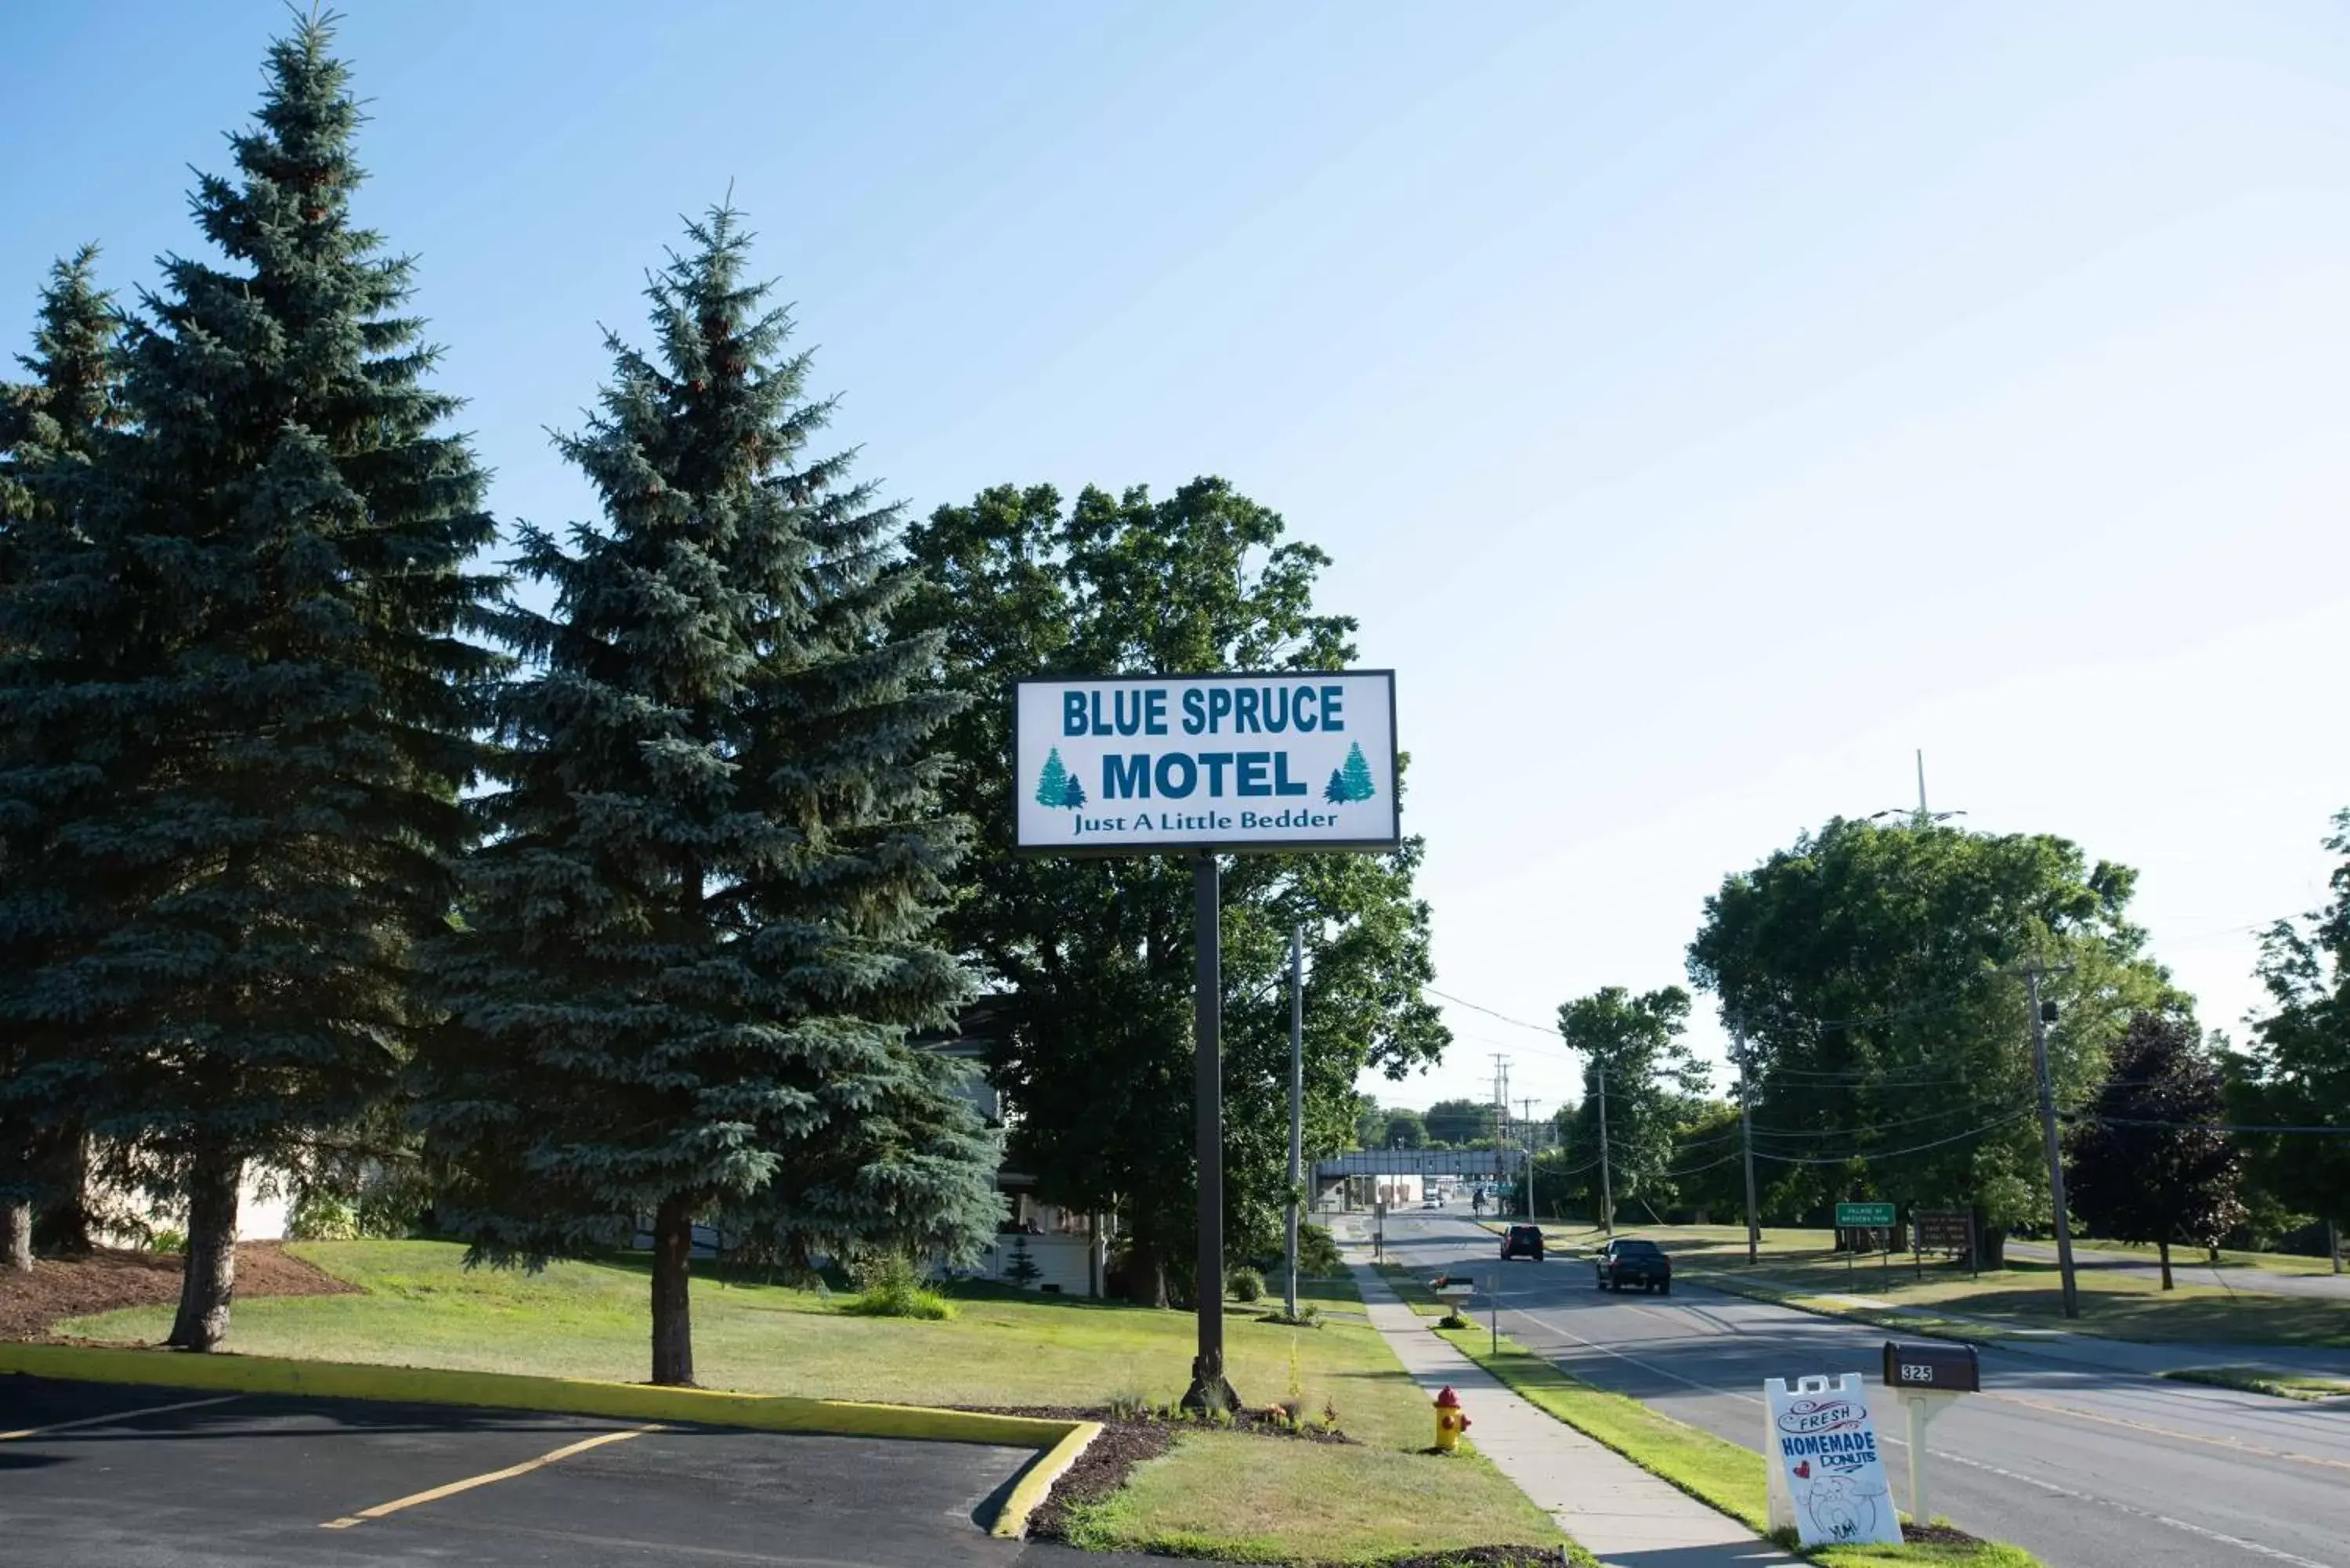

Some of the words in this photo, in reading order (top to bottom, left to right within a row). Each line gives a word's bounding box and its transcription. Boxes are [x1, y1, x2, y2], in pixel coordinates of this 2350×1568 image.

[1063, 689, 1167, 736] BLUE
[1182, 685, 1344, 735] SPRUCE
[1102, 751, 1307, 800] MOTEL
[1074, 813, 1126, 835] Just
[1134, 813, 1153, 830] A
[1162, 811, 1232, 830] Little
[1241, 808, 1339, 829] Bedder
[1903, 1365, 1932, 1381] 325
[1800, 1407, 1850, 1430] FRESH
[1781, 1431, 1876, 1457] HOMEMADE
[1820, 1452, 1877, 1468] DONUTS
